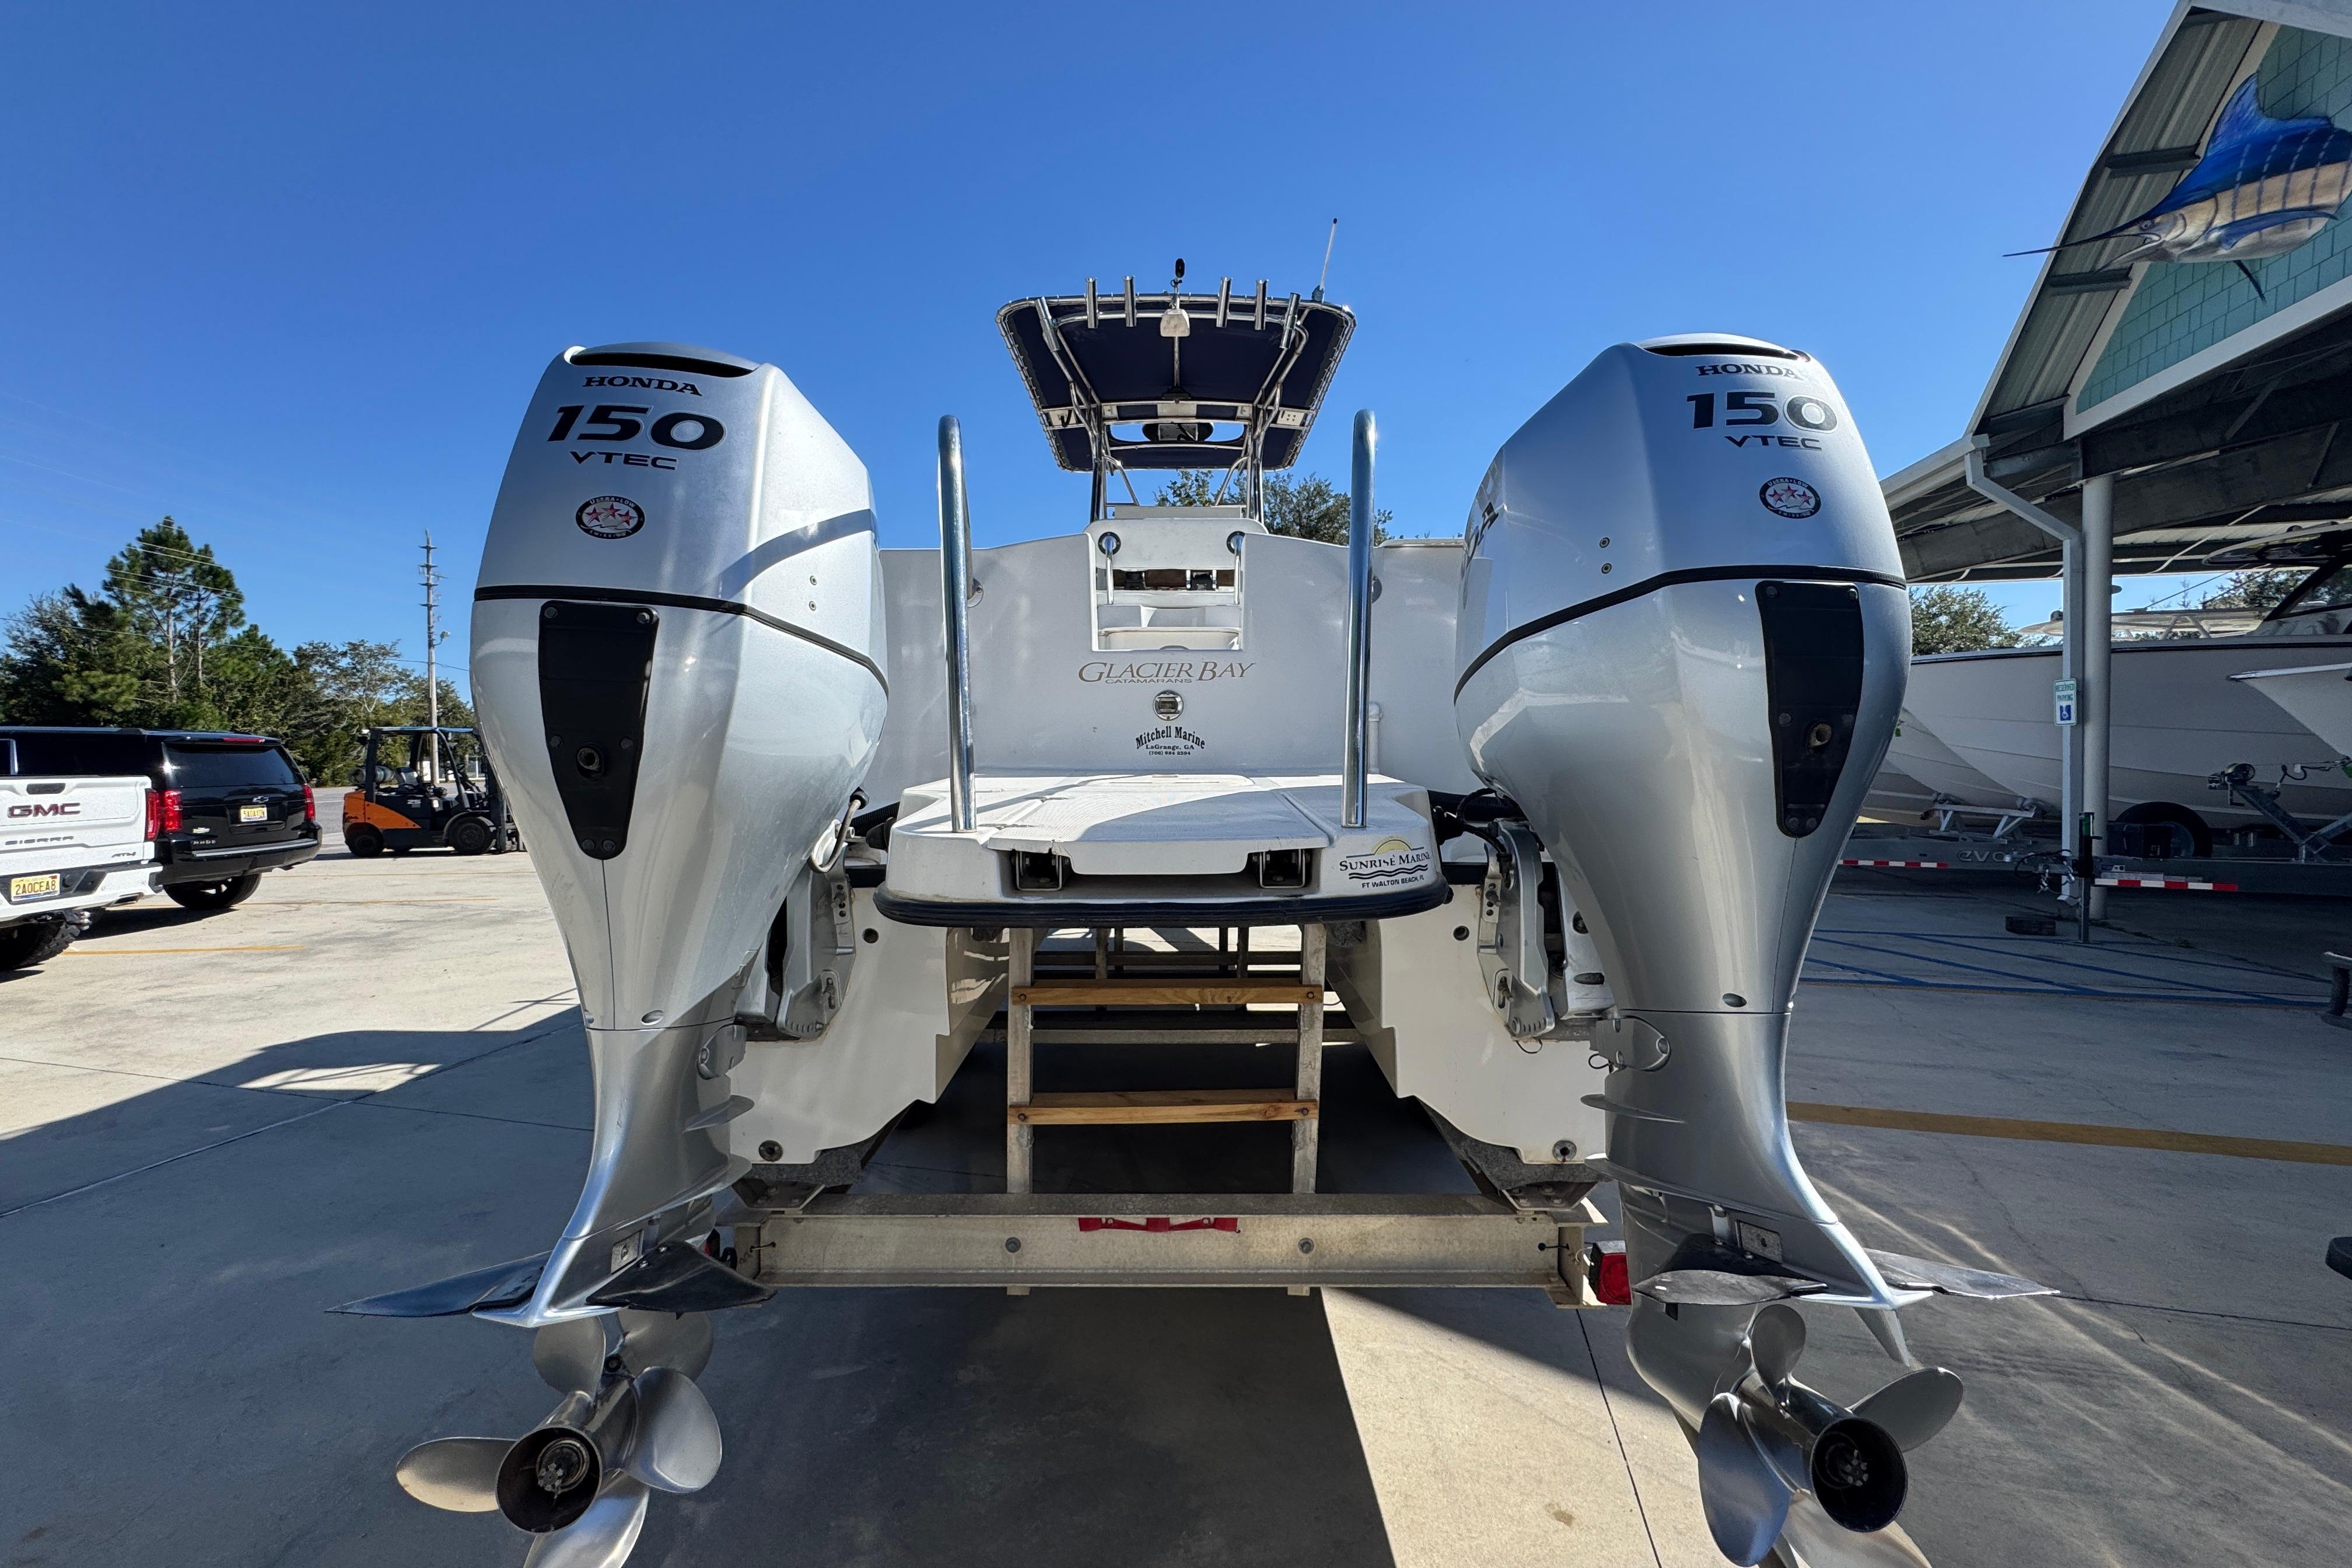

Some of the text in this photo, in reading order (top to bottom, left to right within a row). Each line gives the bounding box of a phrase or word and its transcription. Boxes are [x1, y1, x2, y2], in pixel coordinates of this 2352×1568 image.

[1696, 364, 1805, 380] HONDA
[583, 376, 702, 396] HONDA
[1686, 392, 1838, 431] 150
[547, 405, 725, 450] 150
[1724, 435, 1822, 451] VTEC
[569, 451, 677, 470] VTEC
[1078, 662, 1256, 682] GLACIER BAY
[1135, 726, 1205, 750] Mitchell Marine
[8, 803, 80, 818] GMC
[5, 836, 74, 845] SIERRA
[1399, 851, 1431, 866] MARINE
[1372, 878, 1399, 887] WALTON
